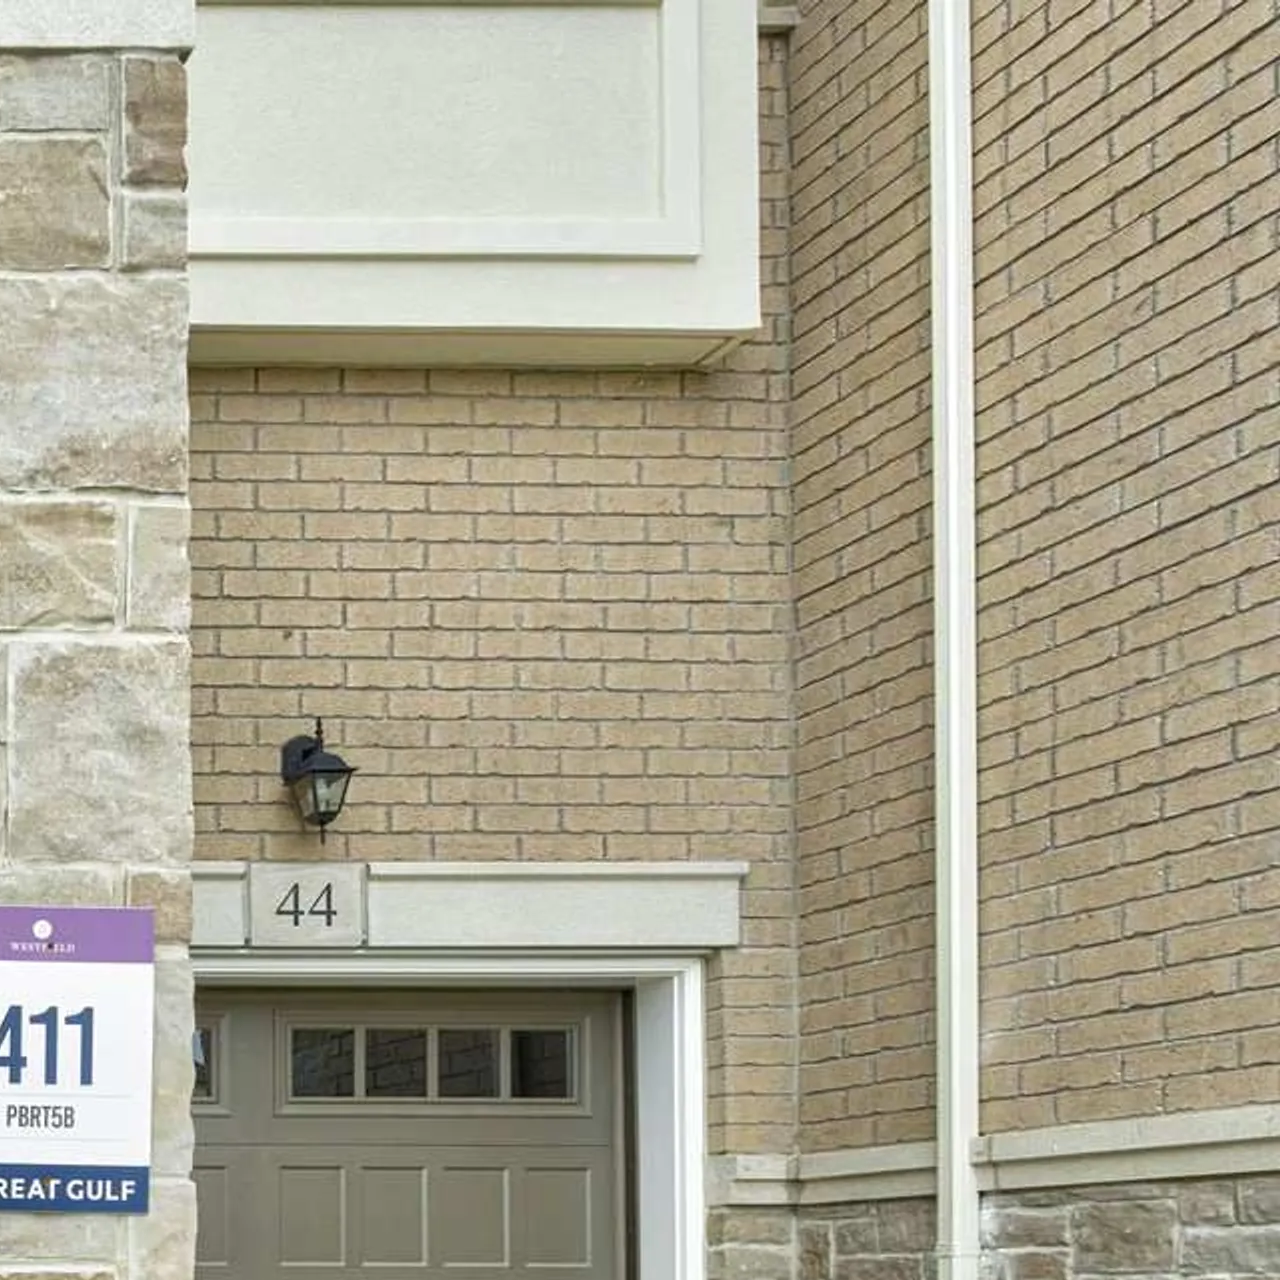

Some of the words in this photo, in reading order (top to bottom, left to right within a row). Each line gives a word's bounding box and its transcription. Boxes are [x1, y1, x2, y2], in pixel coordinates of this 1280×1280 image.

[274, 881, 338, 927] 44
[5, 1104, 76, 1129] PBRT5B
[65, 1179, 137, 1202] GULF
